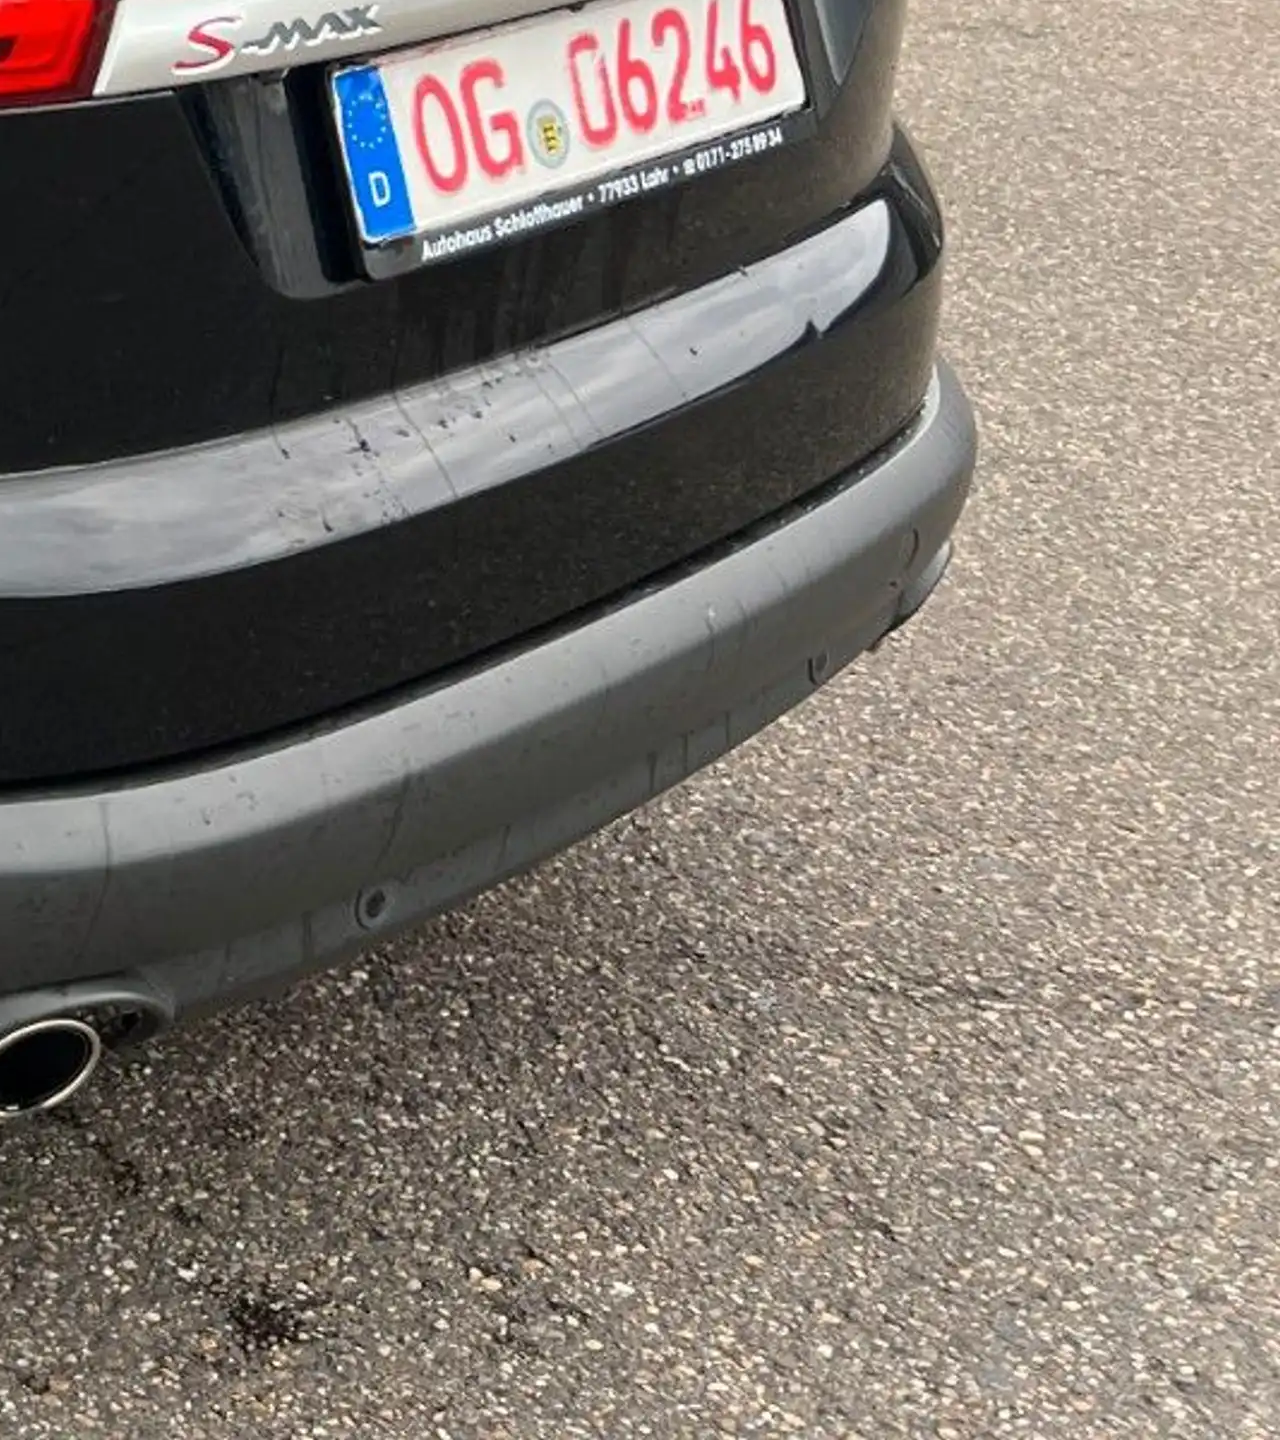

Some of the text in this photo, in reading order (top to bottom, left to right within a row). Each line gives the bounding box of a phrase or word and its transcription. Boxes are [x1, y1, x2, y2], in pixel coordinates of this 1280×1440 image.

[171, 3, 383, 76] S-MAX
[411, 60, 526, 194] OG
[370, 170, 392, 208] D
[422, 224, 491, 260] Autohaus
[598, 174, 638, 203] 77933
[640, 167, 670, 191] Lahr
